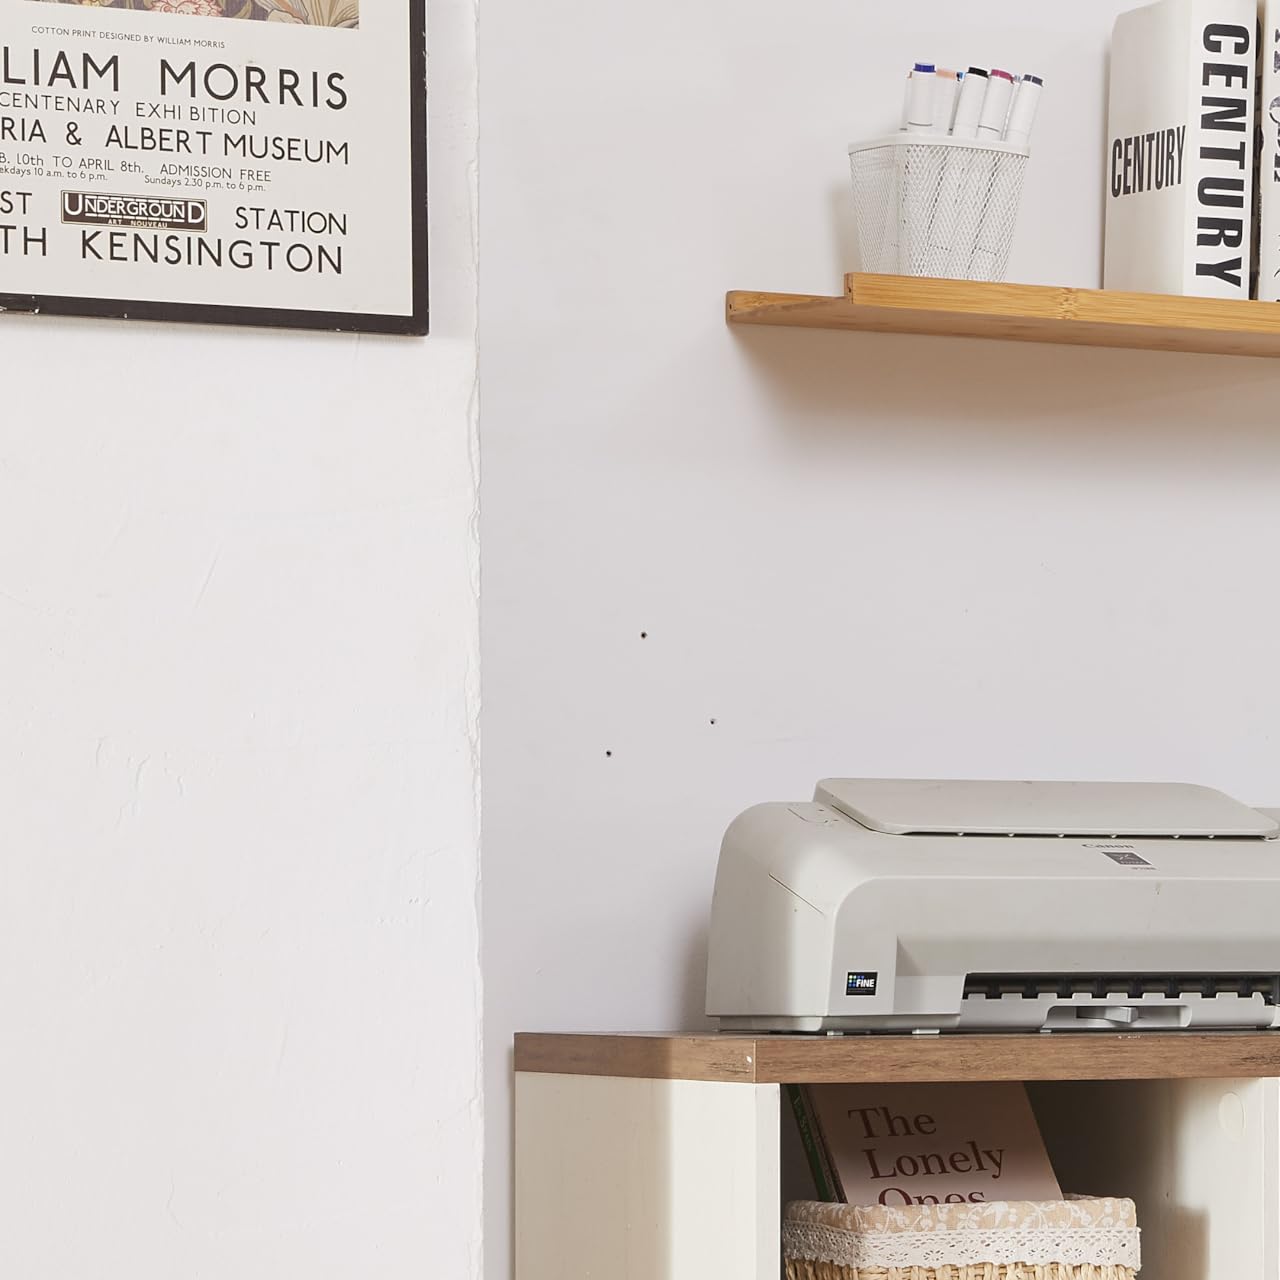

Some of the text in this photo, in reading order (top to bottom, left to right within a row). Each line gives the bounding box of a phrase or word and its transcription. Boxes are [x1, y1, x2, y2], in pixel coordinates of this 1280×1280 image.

[32, 26, 69, 36] COTTON
[72, 29, 96, 38] PRINT
[100, 32, 141, 42] DESIGNED
[157, 36, 191, 46] WILLIAM
[194, 39, 225, 48] MORRIS
[3, 46, 347, 110] LIAM MORRIS
[0, 92, 256, 125] CENTENARY EXHIBITION
[1, 116, 348, 165] RIA & ALBERT MUSEUM
[1196, 23, 1250, 288] CENTURY
[34, 167, 43, 176] 10
[47, 170, 64, 178] a.m.
[67, 171, 77, 179] to
[80, 169, 86, 179] 6
[89, 174, 108, 182] p.m.
[144, 175, 181, 188] Sundays
[184, 177, 202, 187] 2.30
[206, 181, 224, 190] p.m.
[227, 181, 236, 189] to
[239, 181, 244, 190] 6
[248, 184, 266, 192] p.m.
[52, 156, 72, 168] TO
[79, 158, 114, 171] APRIL
[121, 161, 144, 174] 8th.
[160, 164, 232, 179] ADMISSION
[240, 169, 271, 182] FREE
[1112, 125, 1186, 198] CENTURY
[0, 190, 346, 235] ST UNDERGROUND STATION
[131, 220, 168, 228] NOUVEAU
[0, 225, 341, 274] TH KENSINGTON
[856, 979, 874, 987] FINE
[848, 1106, 936, 1138] The
[861, 1140, 1006, 1179] Lonely
